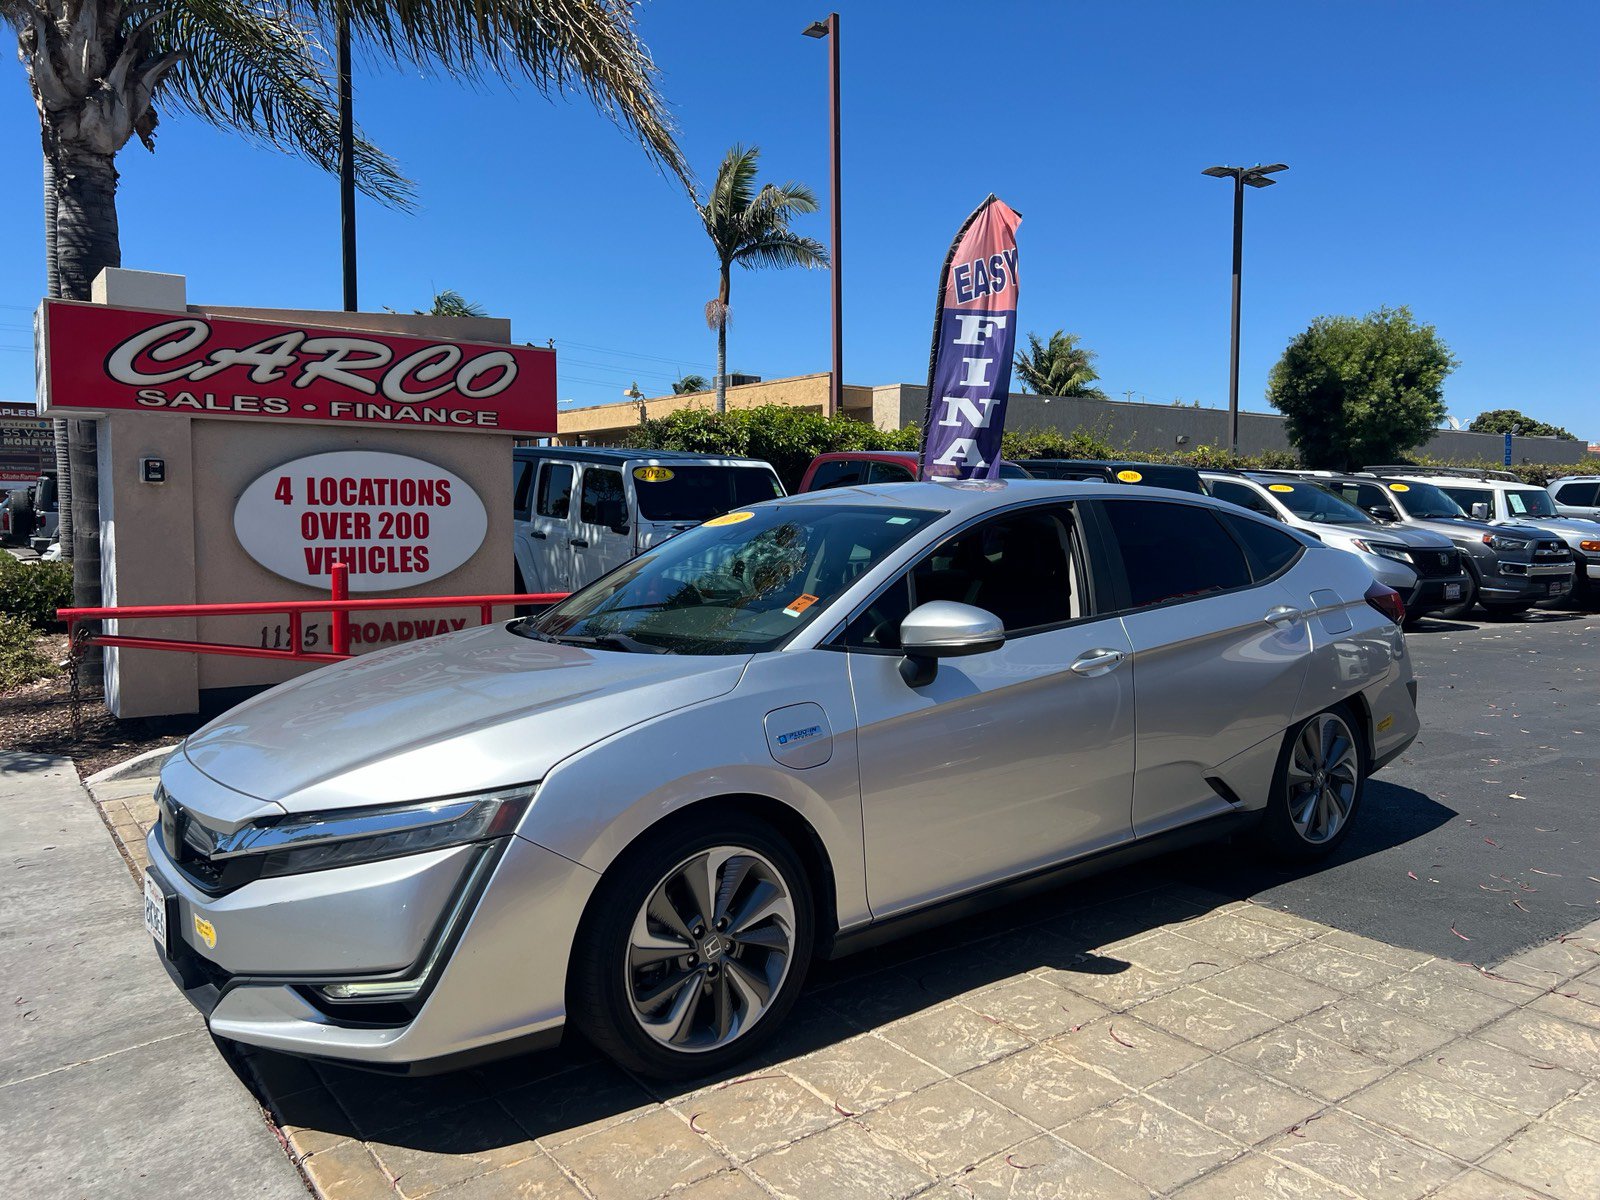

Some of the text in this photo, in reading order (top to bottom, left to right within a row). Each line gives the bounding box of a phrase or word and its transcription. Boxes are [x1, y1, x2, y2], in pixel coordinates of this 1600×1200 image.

[953, 247, 1018, 305] EASY
[105, 318, 519, 403] CARCO
[136, 389, 499, 427] SALES FINANCE
[931, 314, 1006, 482] FINA
[274, 476, 451, 506] 4 LOCATIONS
[641, 469, 666, 479] 2023
[301, 511, 430, 540] OVER 200
[304, 545, 430, 575] VEHICLES
